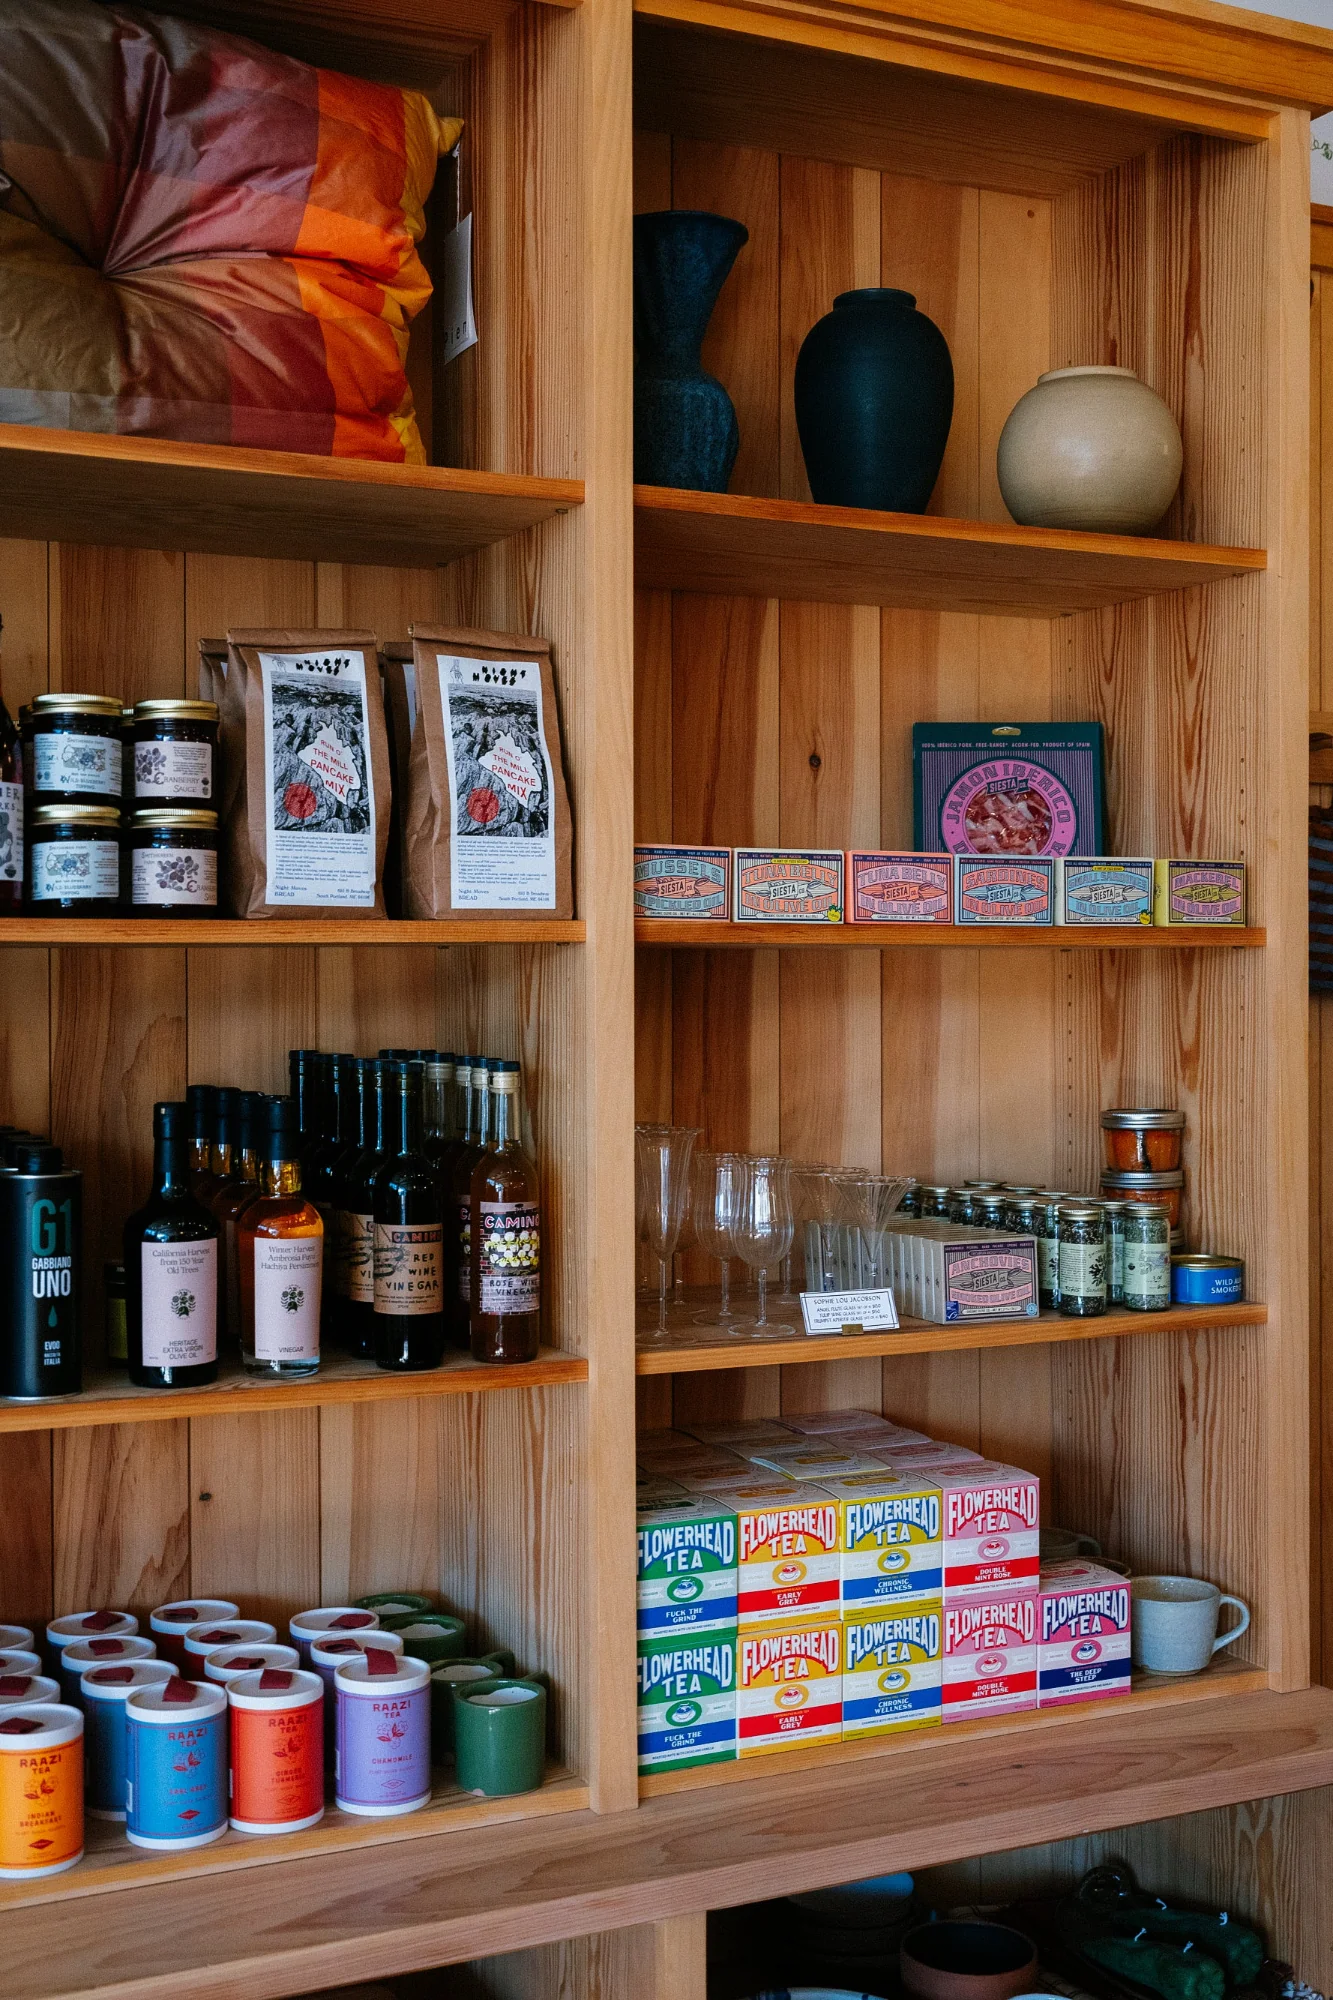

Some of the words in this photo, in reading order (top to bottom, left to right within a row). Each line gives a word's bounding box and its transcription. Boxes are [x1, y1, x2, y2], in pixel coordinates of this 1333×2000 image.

[296, 663, 339, 675] MOVES
[304, 658, 350, 668] NIGHT
[482, 666, 526, 678] NIGHT
[473, 673, 516, 686] MOVES
[321, 740, 334, 752] RUN
[499, 747, 513, 758] RUN
[313, 748, 328, 760] THE
[331, 757, 348, 770] MILL
[493, 754, 509, 766] THE
[510, 762, 529, 773] MILL
[154, 772, 200, 785] CRANBERRY
[310, 760, 354, 784] PANCAKE
[492, 765, 536, 786] PANCAKE
[173, 785, 197, 793] SAUCE
[325, 780, 346, 797] MIX
[508, 784, 527, 800] MIX
[990, 779, 1017, 792] SIESTA
[634, 860, 721, 883] MUSSELS
[743, 865, 786, 885] TUNA
[790, 865, 837, 885] BELLY
[858, 867, 899, 887] TUNA
[902, 867, 945, 889] BELLY
[966, 869, 1045, 890] SARDINES
[1174, 872, 1239, 889] MACKEREL
[661, 881, 683, 894] SIESTA
[773, 884, 796, 897] SIESTA
[886, 887, 908, 899] SIESTA
[990, 888, 1011, 901] SIESTA
[1094, 889, 1113, 901] SIESTA
[1194, 889, 1211, 900] SIESTA
[648, 897, 701, 909] PICKLED
[704, 895, 723, 907] OIL
[745, 893, 760, 908] IN
[764, 900, 809, 912] OLIVE
[812, 896, 835, 910] OIL
[860, 895, 875, 910] IN
[878, 900, 920, 913] OLIVE
[923, 898, 945, 912] OIL
[966, 897, 979, 911] IN
[982, 902, 1022, 915] OLIVE
[1025, 900, 1046, 913] OIL
[31, 1199, 72, 1256] G1
[484, 1214, 539, 1229] CAMINO
[32, 1256, 72, 1270] GABBIANO
[413, 1253, 435, 1263] RED
[261, 1262, 288, 1271] Hachiya
[409, 1266, 436, 1276] WINE
[952, 1256, 1029, 1276] ANCHOVIES
[32, 1269, 71, 1298] UNO
[386, 1280, 439, 1291] VINEGAR
[489, 1278, 513, 1288] ROSÉ
[976, 1273, 997, 1289] SIESTA
[44, 1340, 60, 1350] EVOO
[948, 1485, 1037, 1536] FLOWERHEAD
[846, 1495, 939, 1549] FLOWERHEAD
[974, 1511, 1010, 1534] TEA
[740, 1506, 836, 1561] FLOWERHEAD
[874, 1522, 911, 1545] TEA
[768, 1534, 807, 1557] TEA
[663, 1549, 703, 1573] TEA
[980, 1566, 1006, 1575] DOUBLE
[878, 1579, 909, 1588] CHRONIC
[975, 1574, 992, 1582] MINT
[777, 1591, 802, 1600] EARLY
[874, 1584, 913, 1595] WELLNESS
[779, 1598, 800, 1606] GREY
[666, 1610, 686, 1618] FUCK
[672, 1615, 696, 1623] GRIND
[1043, 1589, 1128, 1641] FLOWERHEAD
[946, 1600, 1034, 1654] FLOWERHEAD
[1068, 1615, 1102, 1637] TEA
[847, 1614, 939, 1669] FLOWERHEAD
[971, 1627, 1008, 1650] TEA
[742, 1629, 839, 1686] FLOWERHEAD
[874, 1642, 911, 1666] TEA
[771, 1658, 810, 1682] TEA
[1070, 1670, 1083, 1678] THE
[661, 1673, 702, 1697] TEA
[1075, 1674, 1096, 1683] STEEP
[977, 1682, 1004, 1691] DOUBLE
[972, 1689, 988, 1698] MINT
[373, 1700, 411, 1712] RAAZI
[874, 1703, 913, 1714] WELLNESS
[878, 1698, 909, 1708] CHRONIC
[268, 1715, 308, 1727] RAAZI
[779, 1715, 804, 1724] EARLY
[781, 1722, 801, 1730] GREY
[168, 1728, 207, 1741] RAAZI
[664, 1734, 684, 1742] FUCK
[672, 1739, 695, 1747] GRIND
[20, 1754, 61, 1768] RAAZI
[372, 1754, 412, 1764] CHAMOMILE
[32, 1766, 50, 1774] TEA
[20, 1815, 62, 1827] BREAKFAST
[28, 1811, 55, 1820] INDIAN
